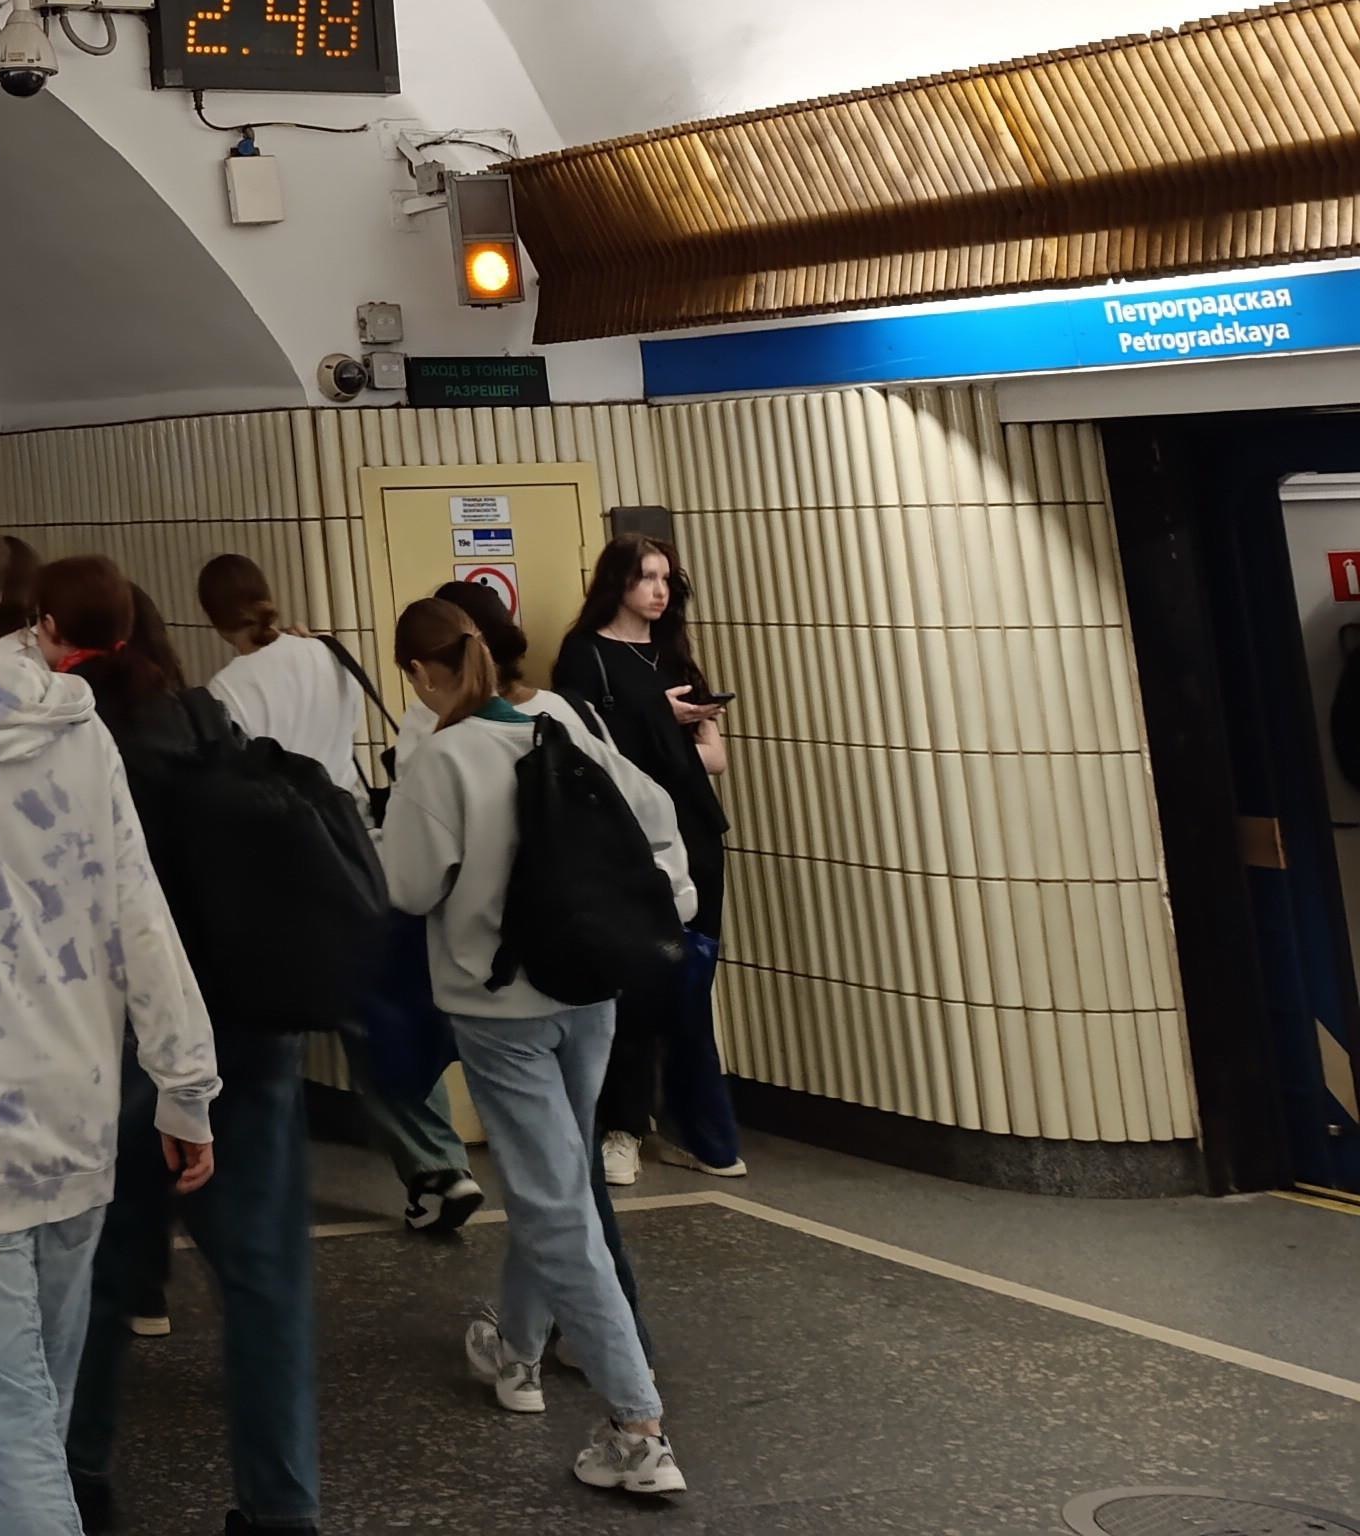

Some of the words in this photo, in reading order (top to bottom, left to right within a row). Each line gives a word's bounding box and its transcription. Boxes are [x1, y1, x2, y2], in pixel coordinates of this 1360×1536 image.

[1103, 288, 1293, 325] Петроградская
[1118, 321, 1291, 353] Petrogradskaya
[421, 365, 459, 378] ВХОД
[461, 365, 472, 377] В
[475, 364, 539, 377] ТОННЕЛЬ
[444, 385, 520, 397] РАЗРЕШЕН
